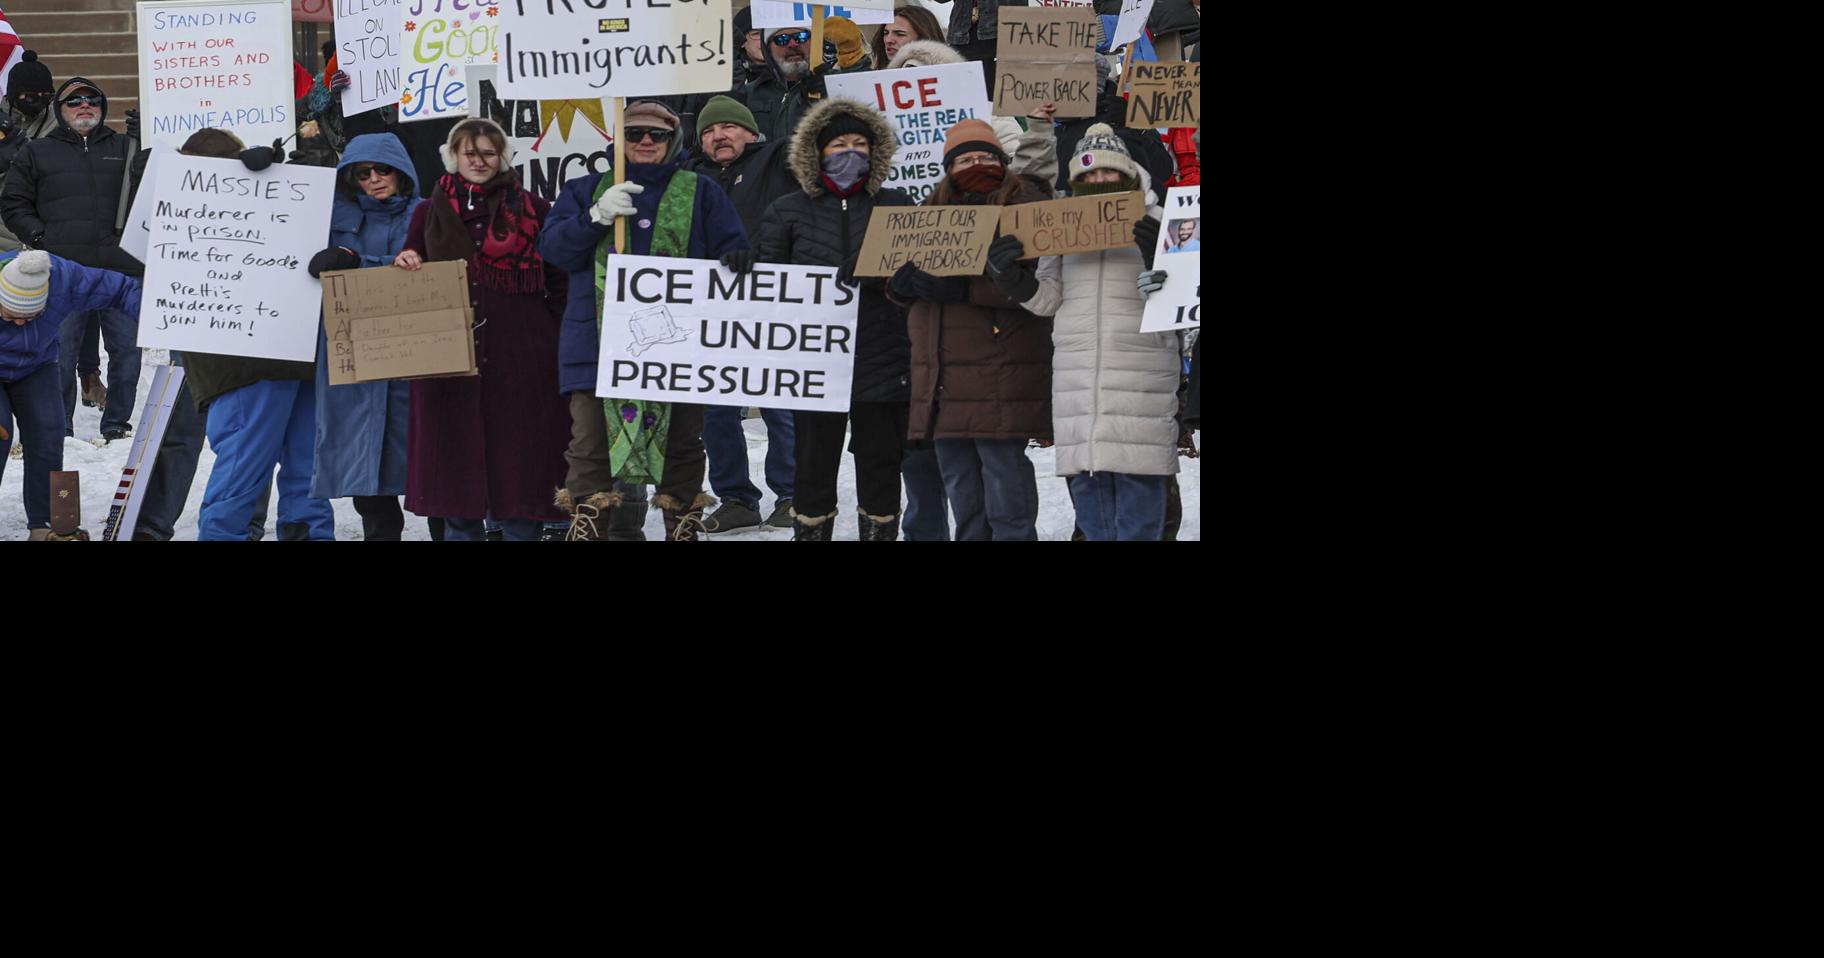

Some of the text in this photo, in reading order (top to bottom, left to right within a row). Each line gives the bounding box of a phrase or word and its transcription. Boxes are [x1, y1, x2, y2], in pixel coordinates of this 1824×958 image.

[154, 11, 257, 30] STANDING
[365, 18, 384, 33] ON
[1002, 21, 1097, 48] TAKE THE
[153, 38, 234, 53] WITH OUR
[505, 19, 727, 89] Immigrants!
[154, 53, 270, 70] SISTERS AND
[155, 74, 252, 91] BROTHERS
[1136, 65, 1187, 80] NEVER
[359, 67, 400, 104] LAN
[874, 77, 942, 112] ICE
[998, 73, 1091, 109] POWER BACK
[200, 98, 212, 107] in
[1129, 90, 1195, 125] NEVER
[153, 105, 286, 134] MINNEAPOLIS
[896, 112, 930, 129] THE
[905, 150, 931, 161] AND
[885, 162, 944, 181] OMES
[181, 169, 310, 201] MASSIE'S
[156, 200, 255, 221] Murderer
[886, 209, 977, 229] PROTECT OUR
[1014, 198, 1130, 231] I like my ICE
[891, 231, 974, 248] IMMIGRANT
[154, 243, 200, 262] Time
[206, 247, 233, 263] for
[879, 243, 984, 272] NEIGHBORS!
[170, 282, 231, 299] Pretti's
[616, 267, 855, 306] ICE MELTS
[256, 302, 279, 317] to
[700, 319, 851, 354] UNDER
[611, 359, 826, 399] PRESSURE
